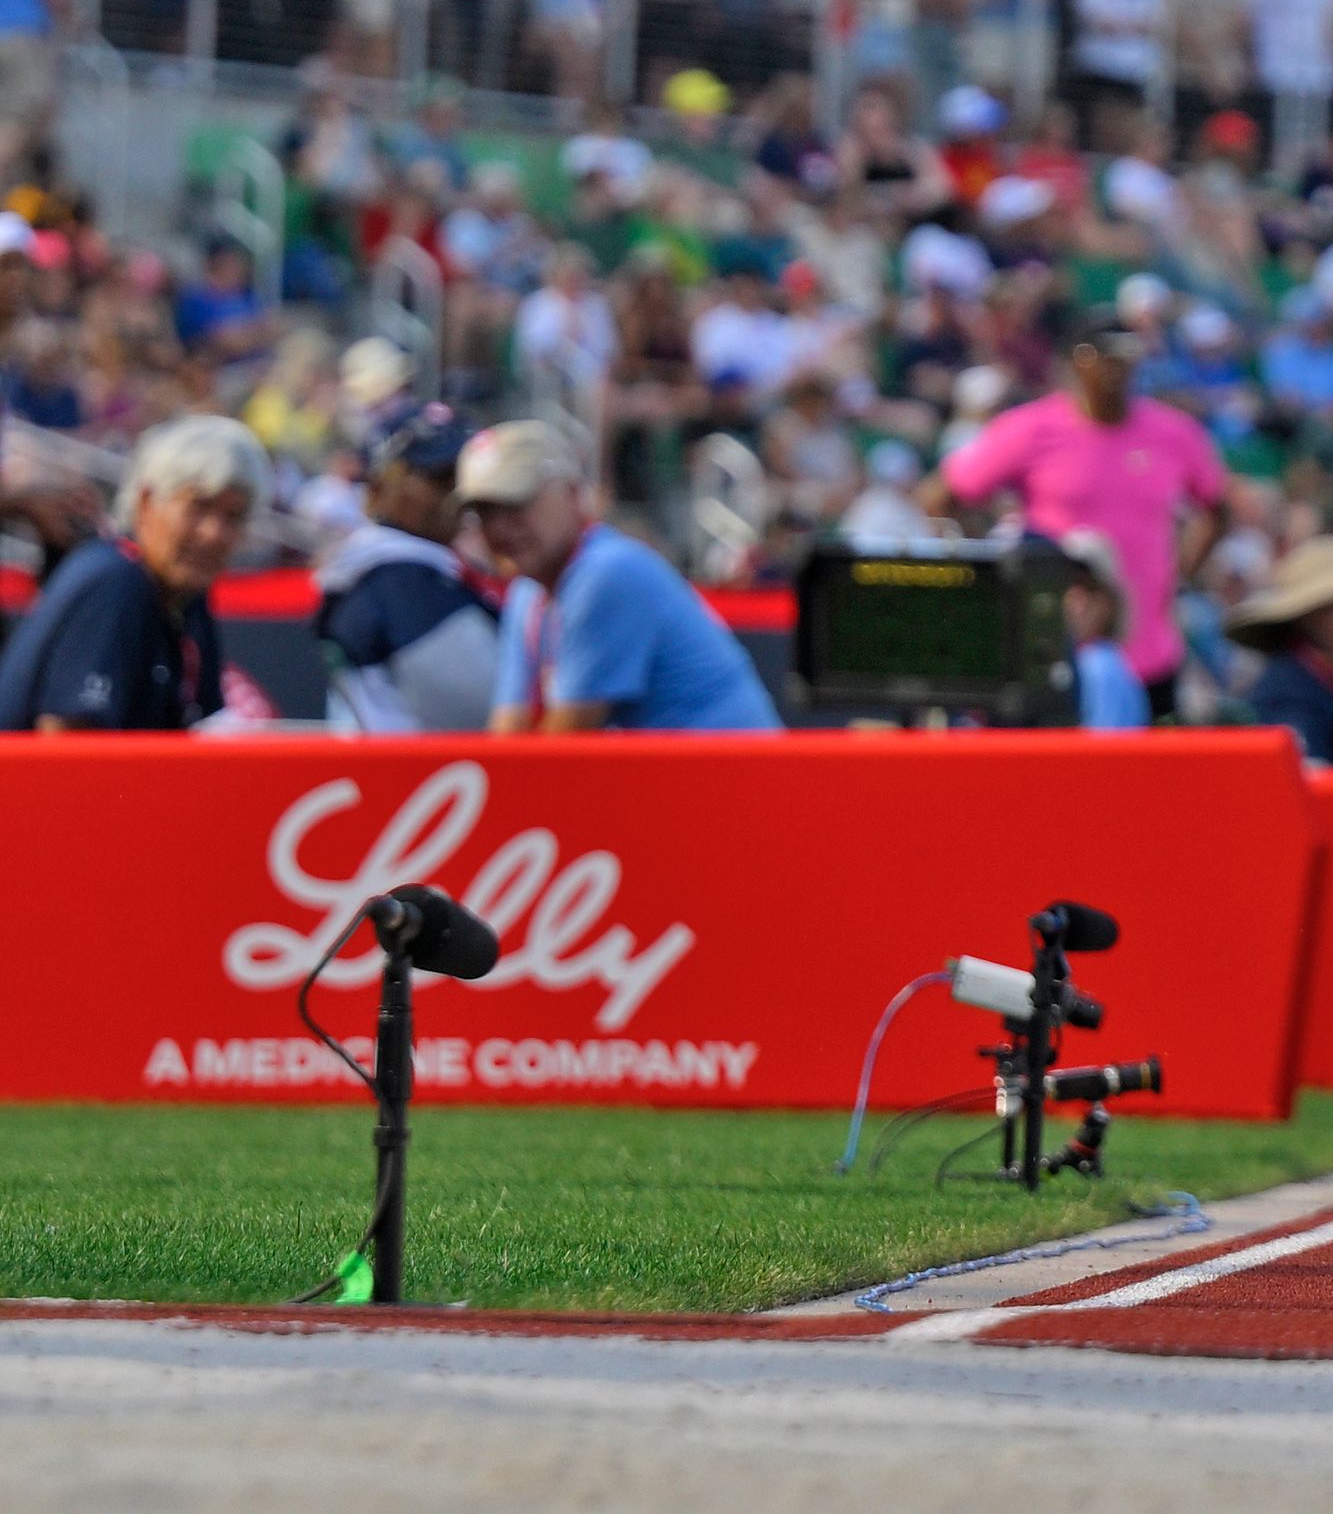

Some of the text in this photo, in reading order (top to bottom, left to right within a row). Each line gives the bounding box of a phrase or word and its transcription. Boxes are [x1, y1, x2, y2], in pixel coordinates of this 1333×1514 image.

[222, 759, 698, 1032] Llly
[143, 1038, 760, 1090] A MEDICNE COMPANY
